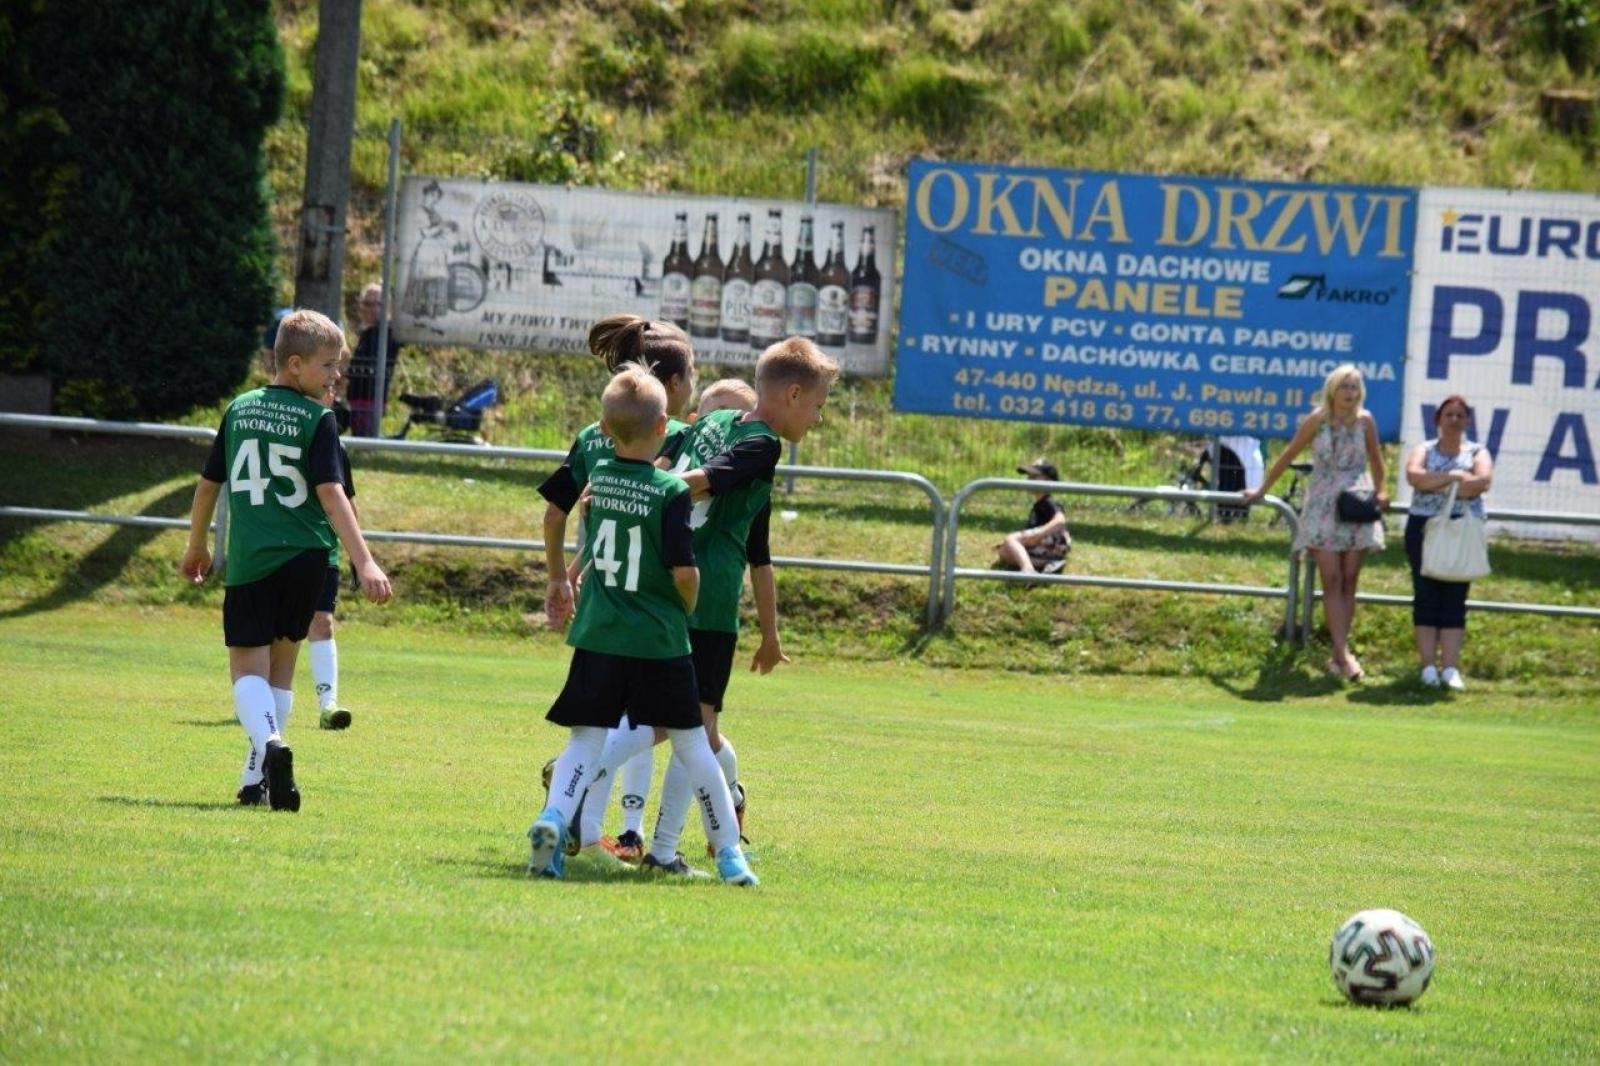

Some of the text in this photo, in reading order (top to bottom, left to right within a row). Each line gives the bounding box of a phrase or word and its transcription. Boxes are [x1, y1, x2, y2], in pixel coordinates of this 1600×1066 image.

[915, 168, 1410, 258] OKNA DRZWI
[1019, 246, 1108, 274] OKNA
[1117, 254, 1270, 283] DACHOWE
[1044, 275, 1244, 318] PANELE
[1051, 318, 1106, 338] PCV
[1130, 323, 1353, 350] GONTA PAPOWE
[1427, 285, 1600, 388] PR
[921, 334, 1395, 381] RYNNY DACHÓWKA CERAMICNA
[953, 368, 1037, 390] 47-440
[1044, 373, 1126, 400] Nędza,
[1134, 381, 1162, 399] ul.
[1171, 383, 1193, 401] J.
[1201, 384, 1277, 406] Pawła
[952, 391, 992, 412] tel.
[999, 395, 1045, 415] 032
[1052, 400, 1097, 419] 418
[1104, 403, 1134, 422] 63
[1145, 405, 1181, 427] 77,
[1189, 408, 1234, 429] 696
[1243, 411, 1288, 431] 213
[230, 438, 308, 509] 45
[592, 496, 653, 518] WORKÓW
[593, 518, 641, 592] 41
